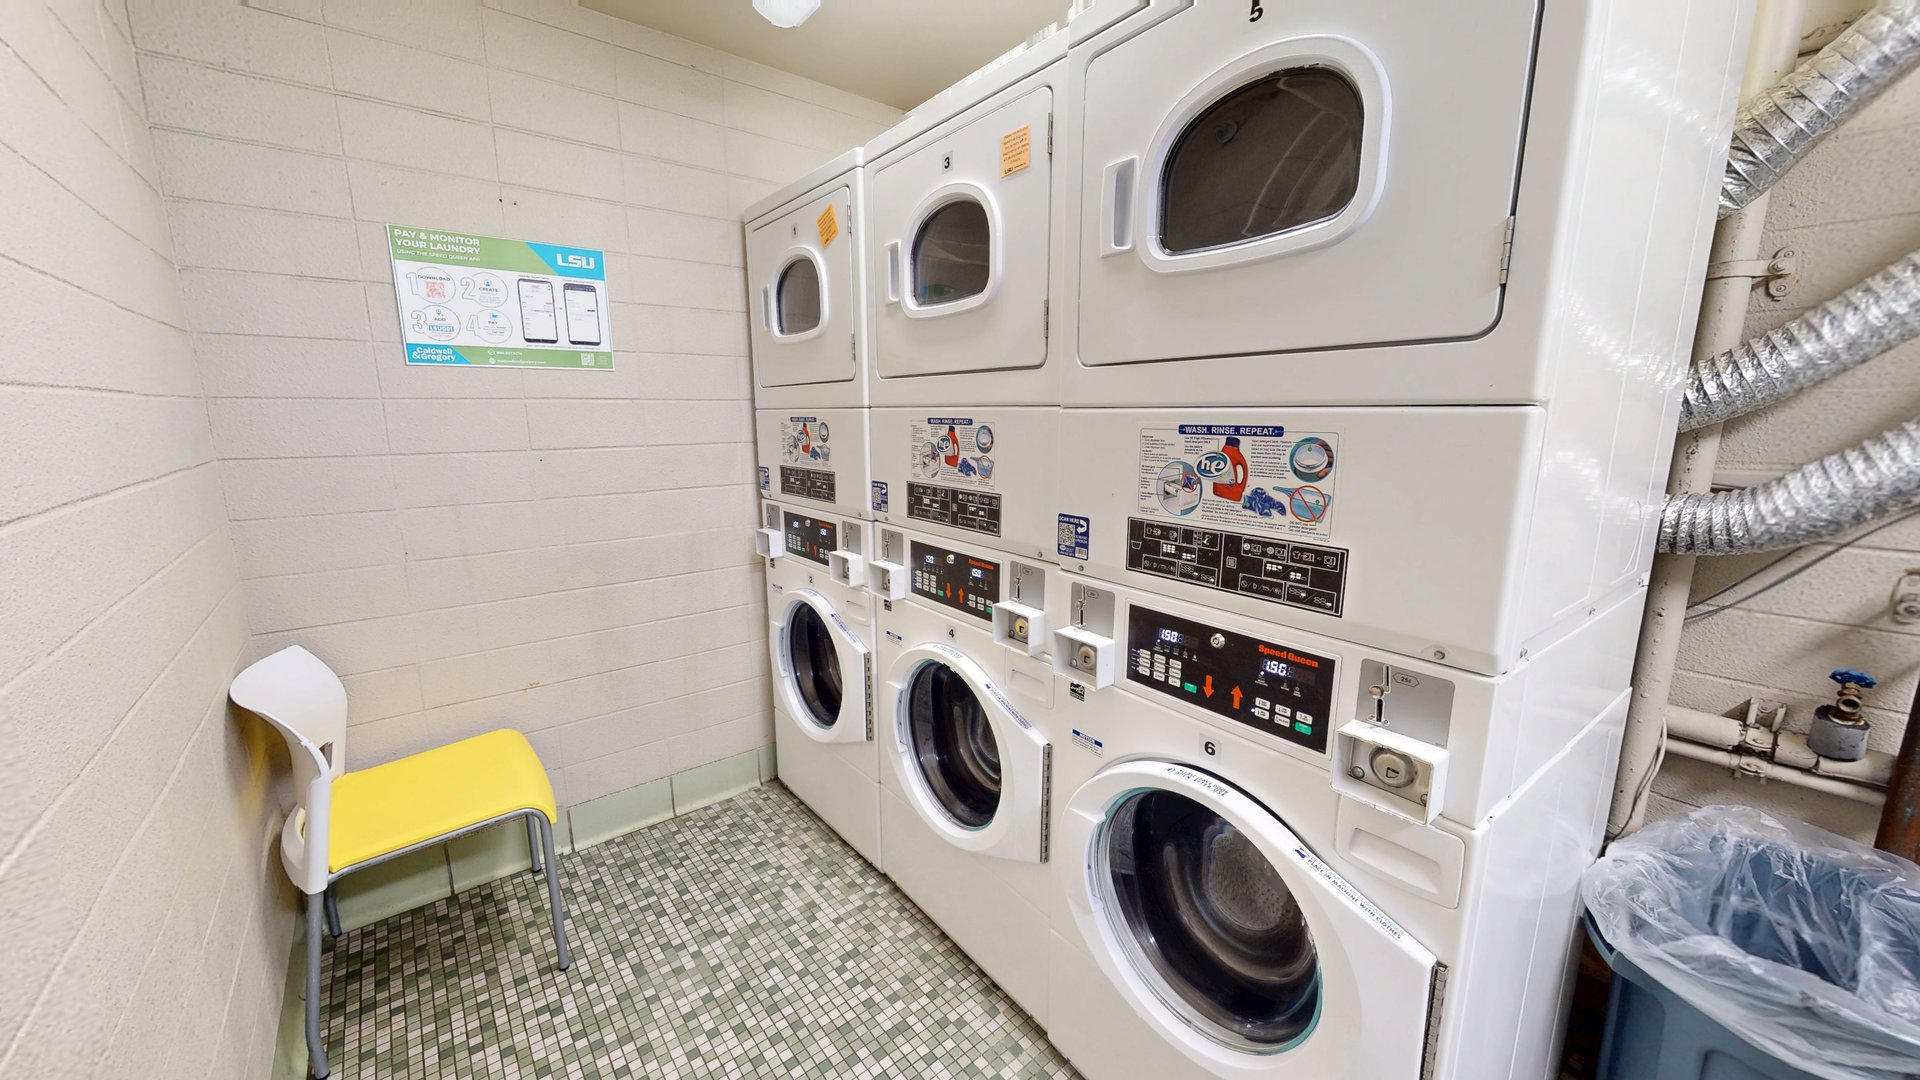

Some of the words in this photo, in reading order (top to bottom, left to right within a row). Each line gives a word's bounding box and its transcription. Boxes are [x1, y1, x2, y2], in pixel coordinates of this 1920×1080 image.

[1249, 0, 1263, 22] 5
[944, 157, 951, 169] 3
[394, 229, 416, 238] PAY
[419, 232, 427, 240] &
[430, 233, 480, 246] MONITOR
[394, 238, 427, 249] YOUR
[430, 243, 481, 255] LAUNDRY
[556, 252, 595, 269] LSU
[418, 274, 451, 282] DOWNLOAD
[416, 346, 453, 355] Caldwell
[1184, 426, 1209, 434] WASH.
[1211, 427, 1238, 435] RINSE.
[1240, 427, 1275, 436] REPEAT.
[1200, 457, 1225, 475] he
[809, 576, 813, 584] 2
[948, 629, 955, 638] 4
[1258, 644, 1287, 660] Speed
[1287, 651, 1319, 668] Queen
[1204, 741, 1216, 756] 6
[1307, 859, 1324, 874] PLACE
[1332, 879, 1359, 903] MACHINE
[1359, 902, 1376, 917] WITH
[1376, 917, 1402, 939] CLOTHES
